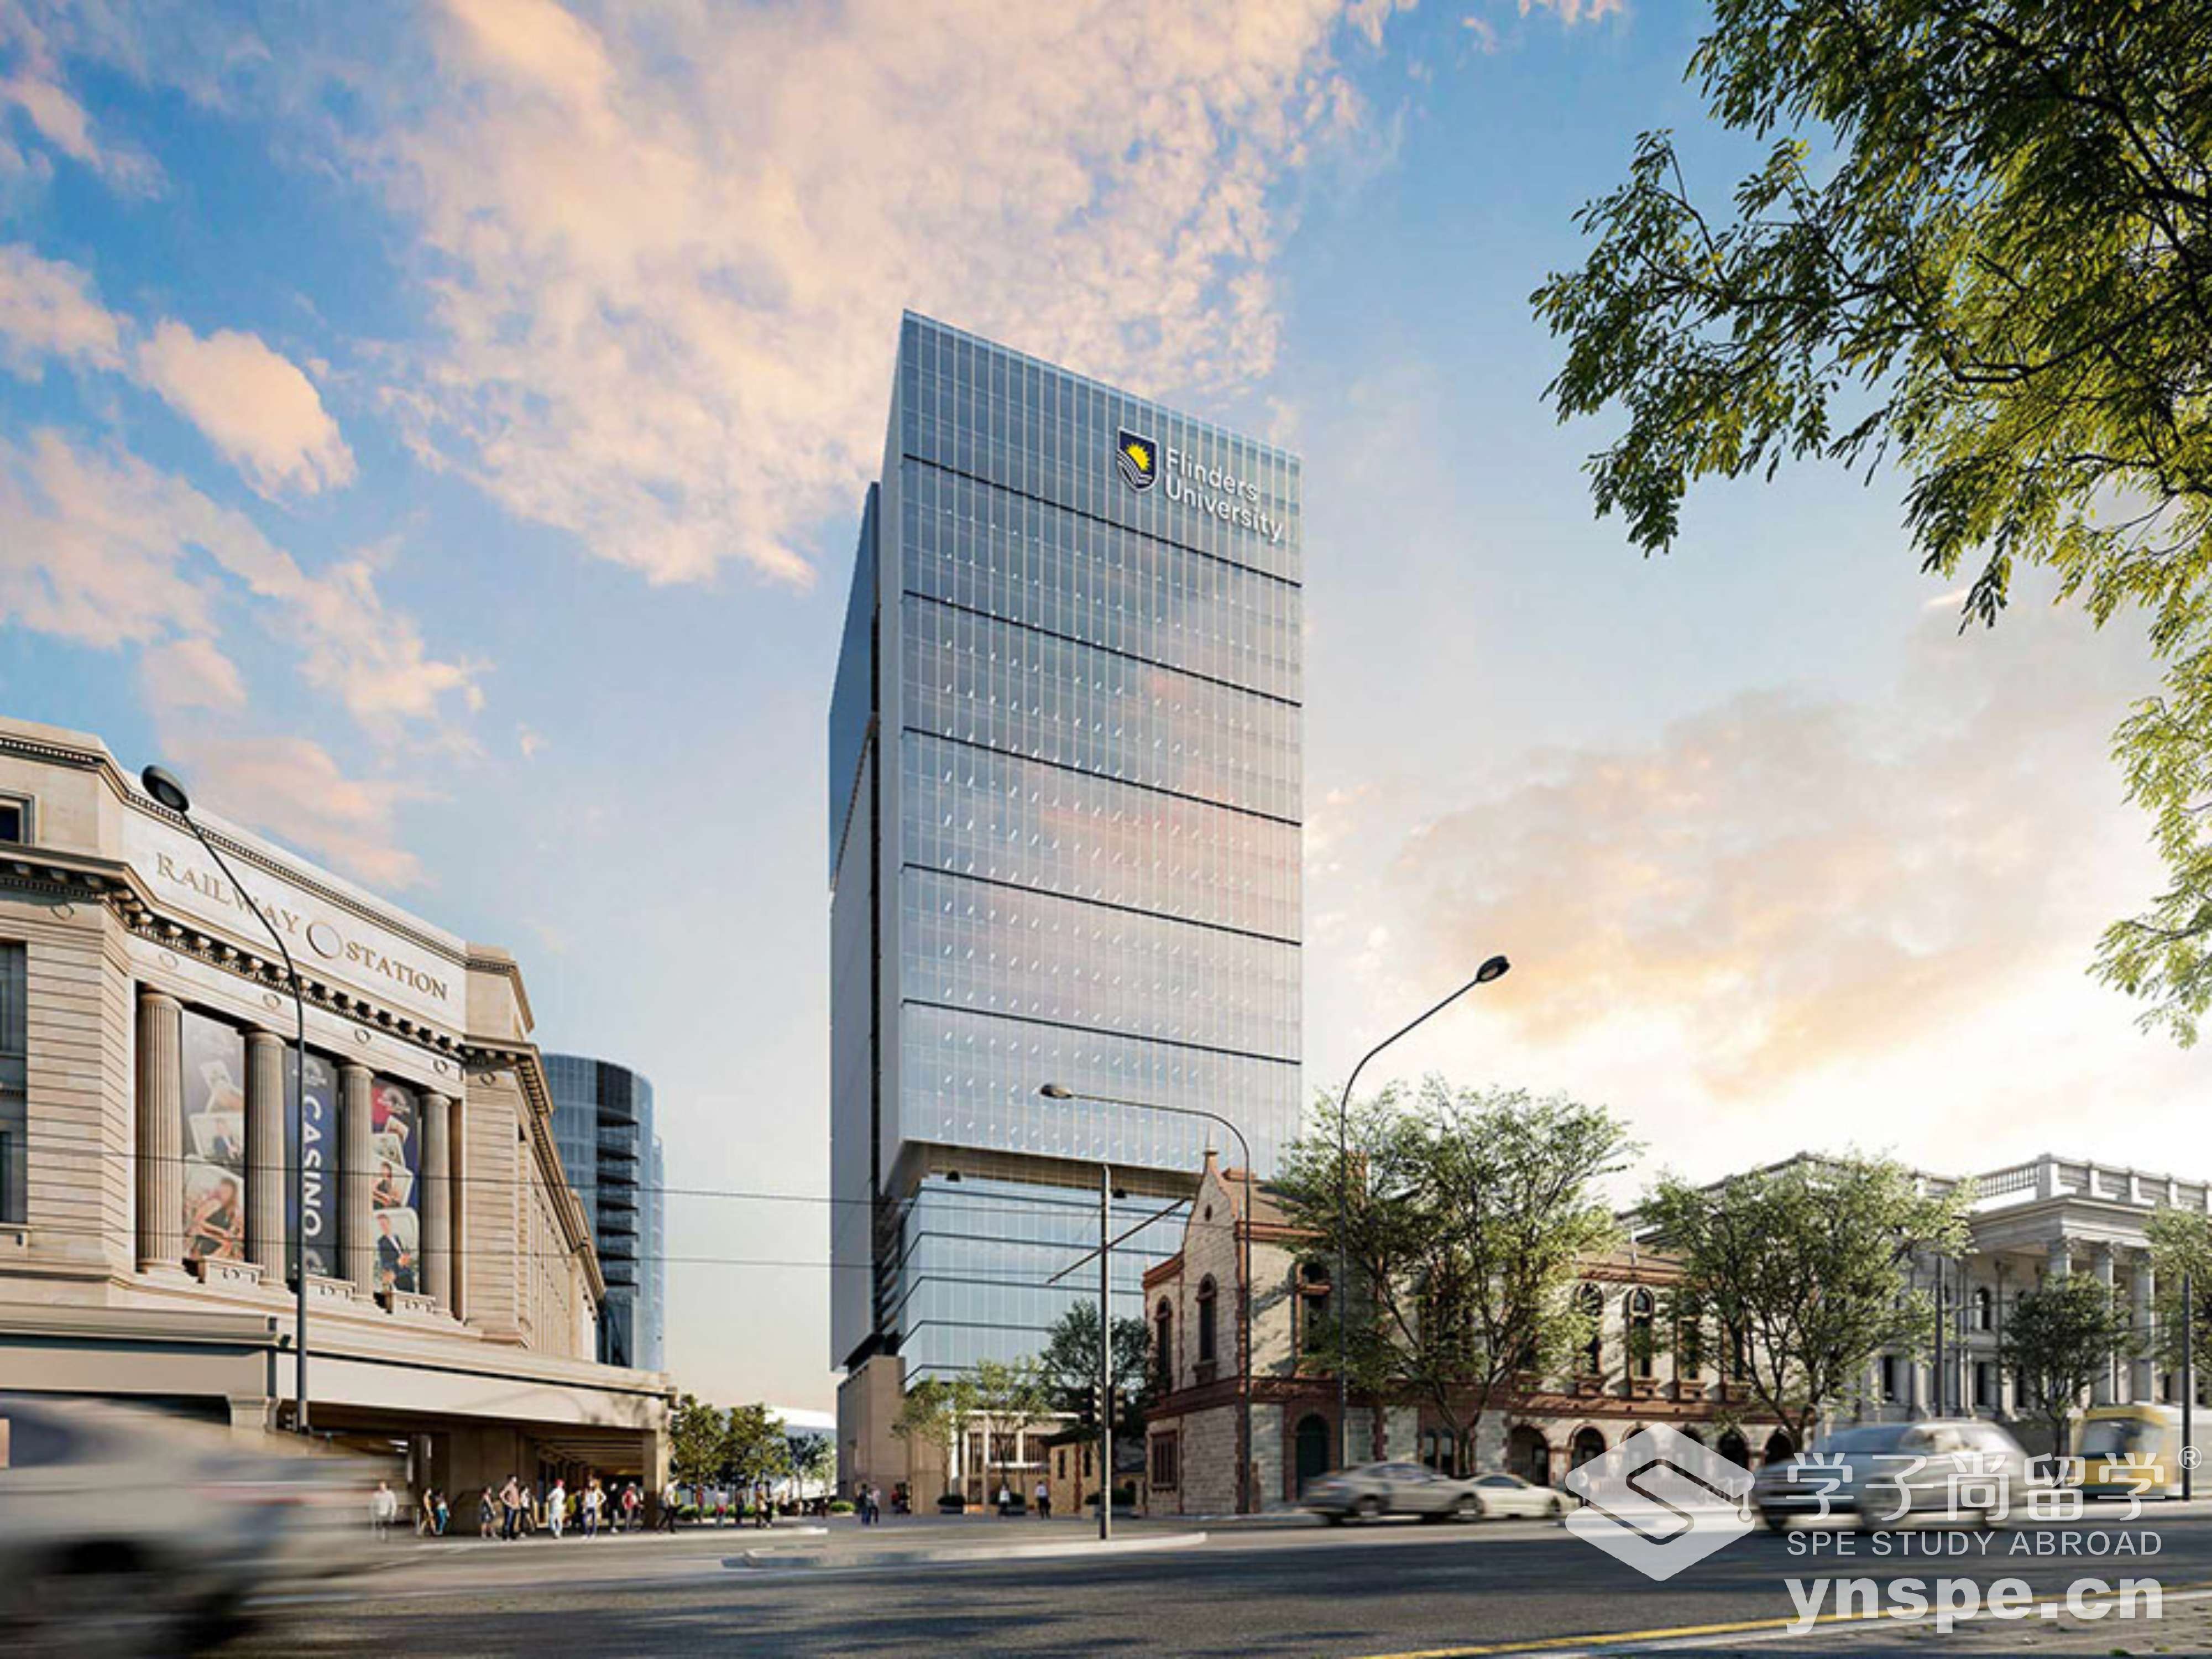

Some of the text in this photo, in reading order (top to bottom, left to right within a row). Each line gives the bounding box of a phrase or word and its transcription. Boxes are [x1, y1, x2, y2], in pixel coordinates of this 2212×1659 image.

[1165, 474, 1283, 542] University
[1167, 447, 1257, 500] Flinders
[156, 853, 447, 1001] RAILWAY STATION
[303, 1094, 322, 1236] CASINO
